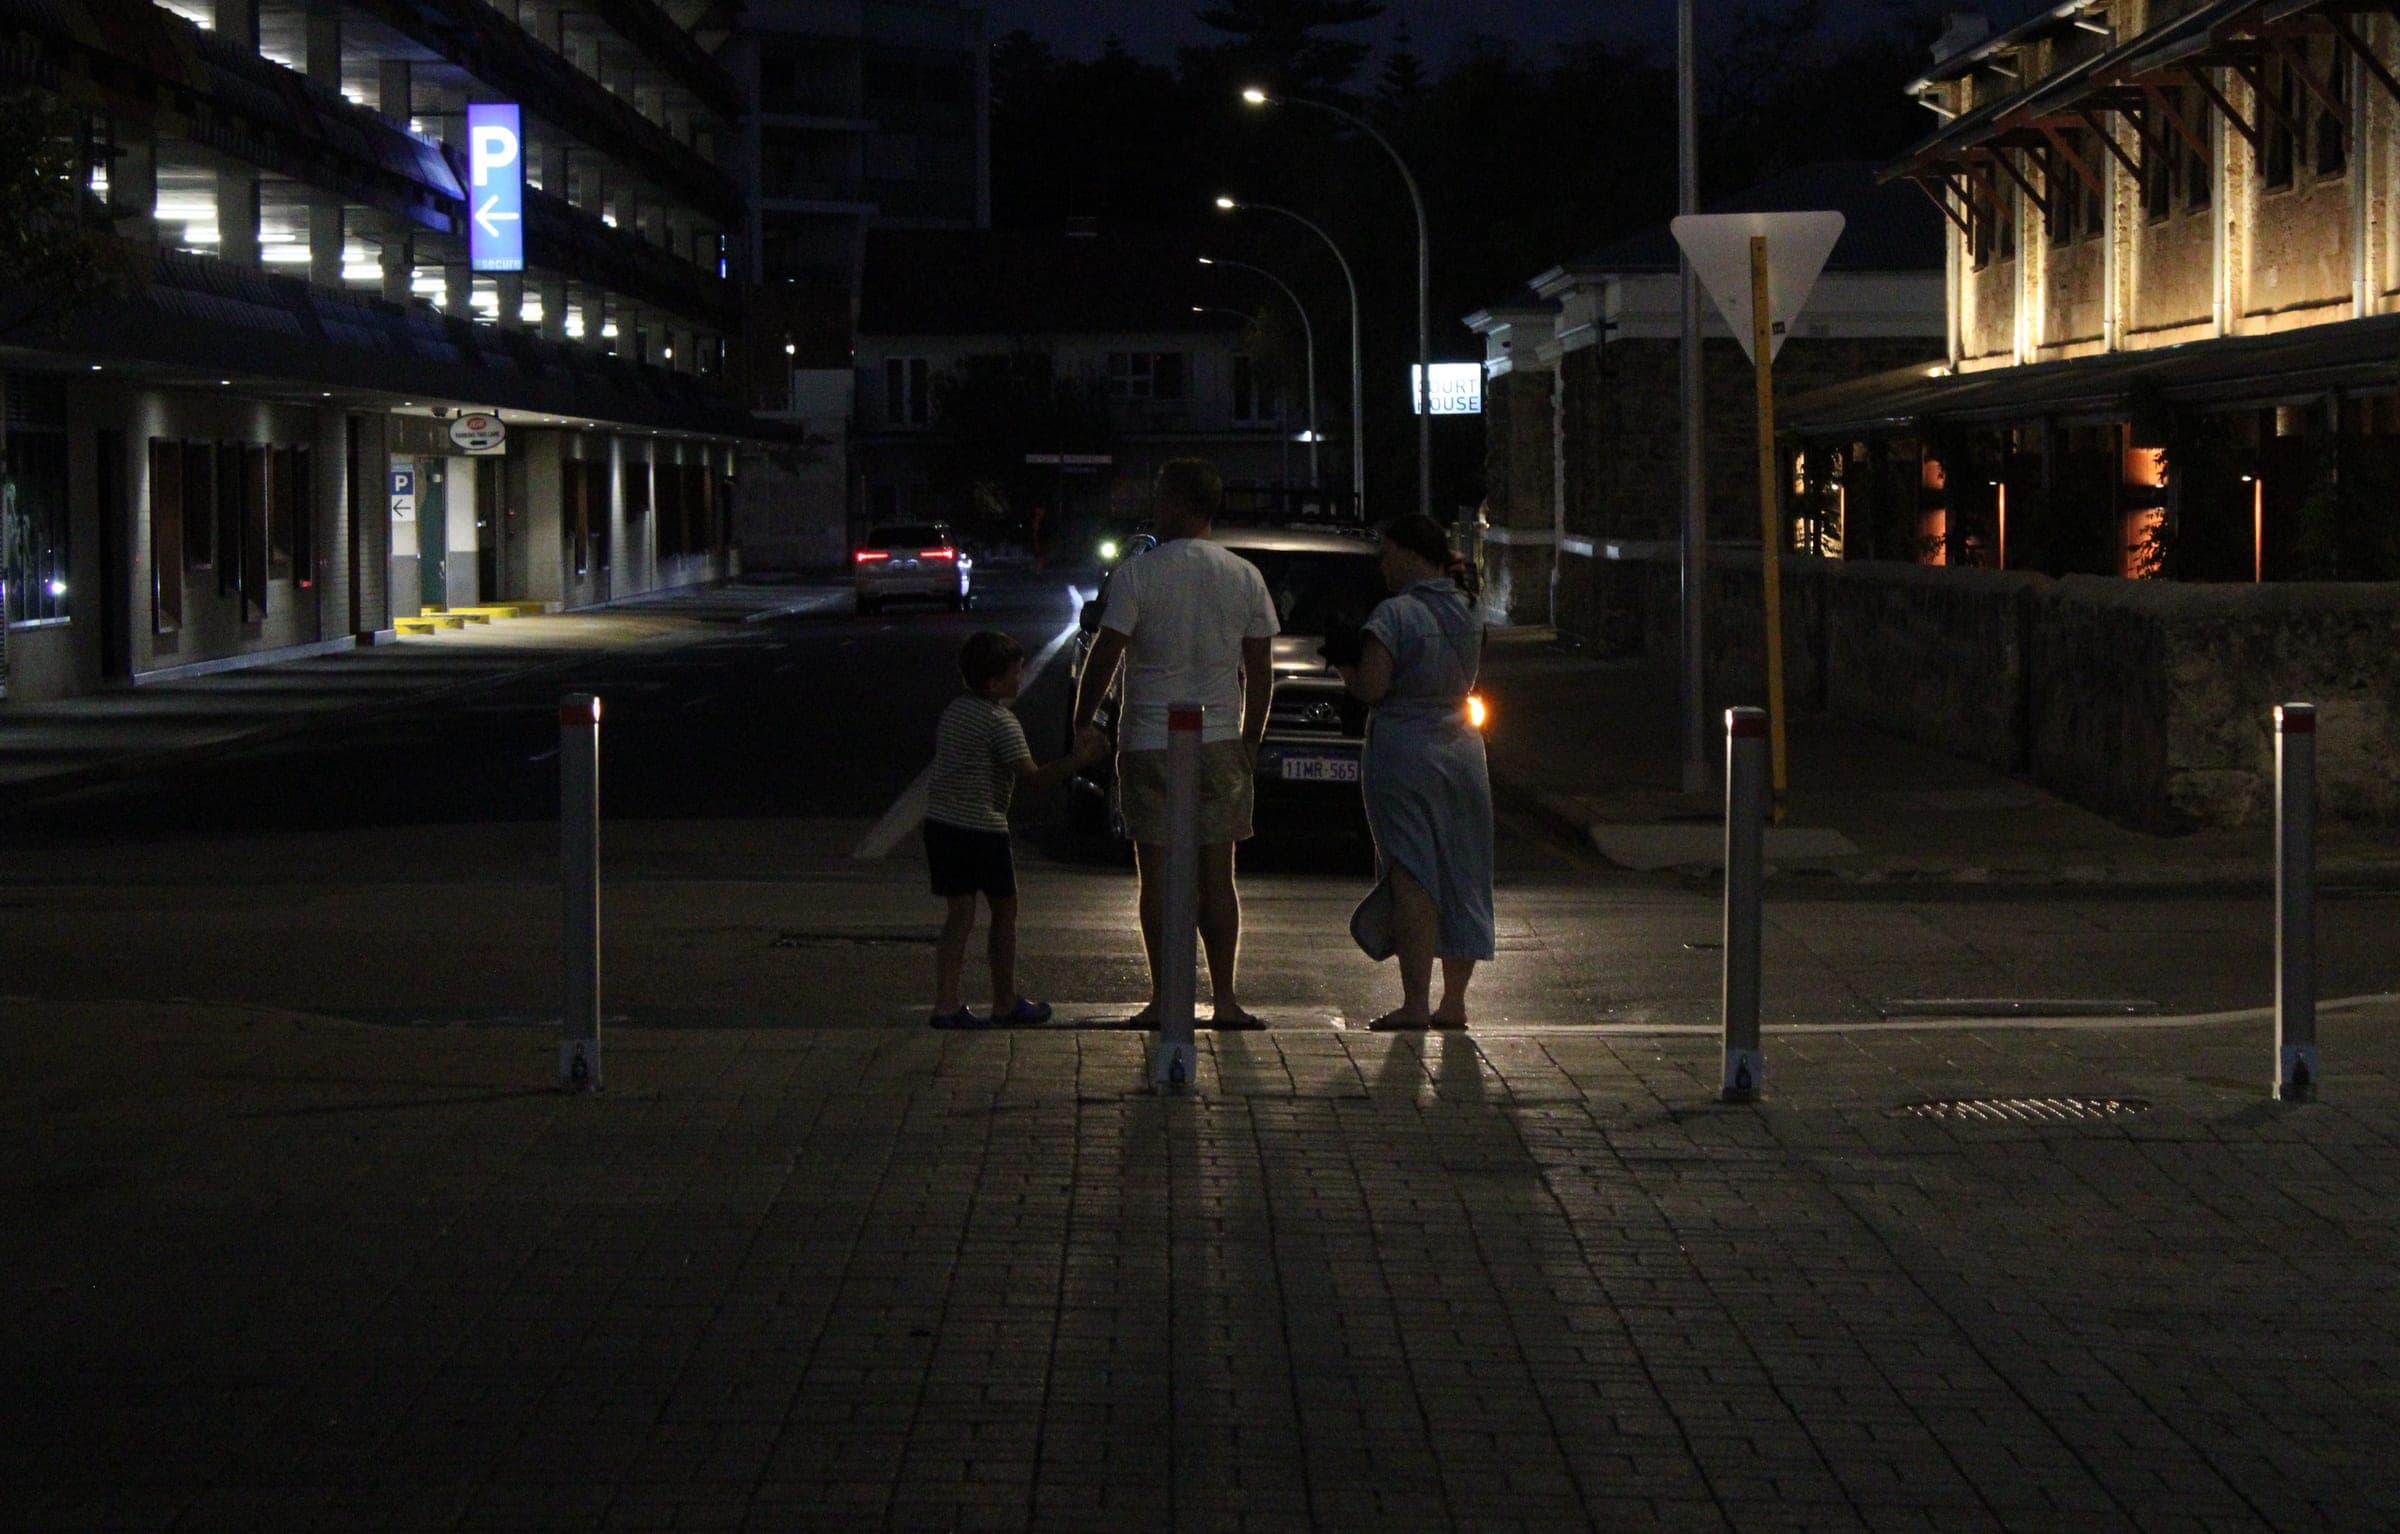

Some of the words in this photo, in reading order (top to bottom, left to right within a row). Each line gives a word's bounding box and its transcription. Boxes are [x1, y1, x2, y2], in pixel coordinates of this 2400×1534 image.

[473, 126, 518, 186] P
[1418, 379, 1477, 393] OURT
[395, 475, 408, 492] P
